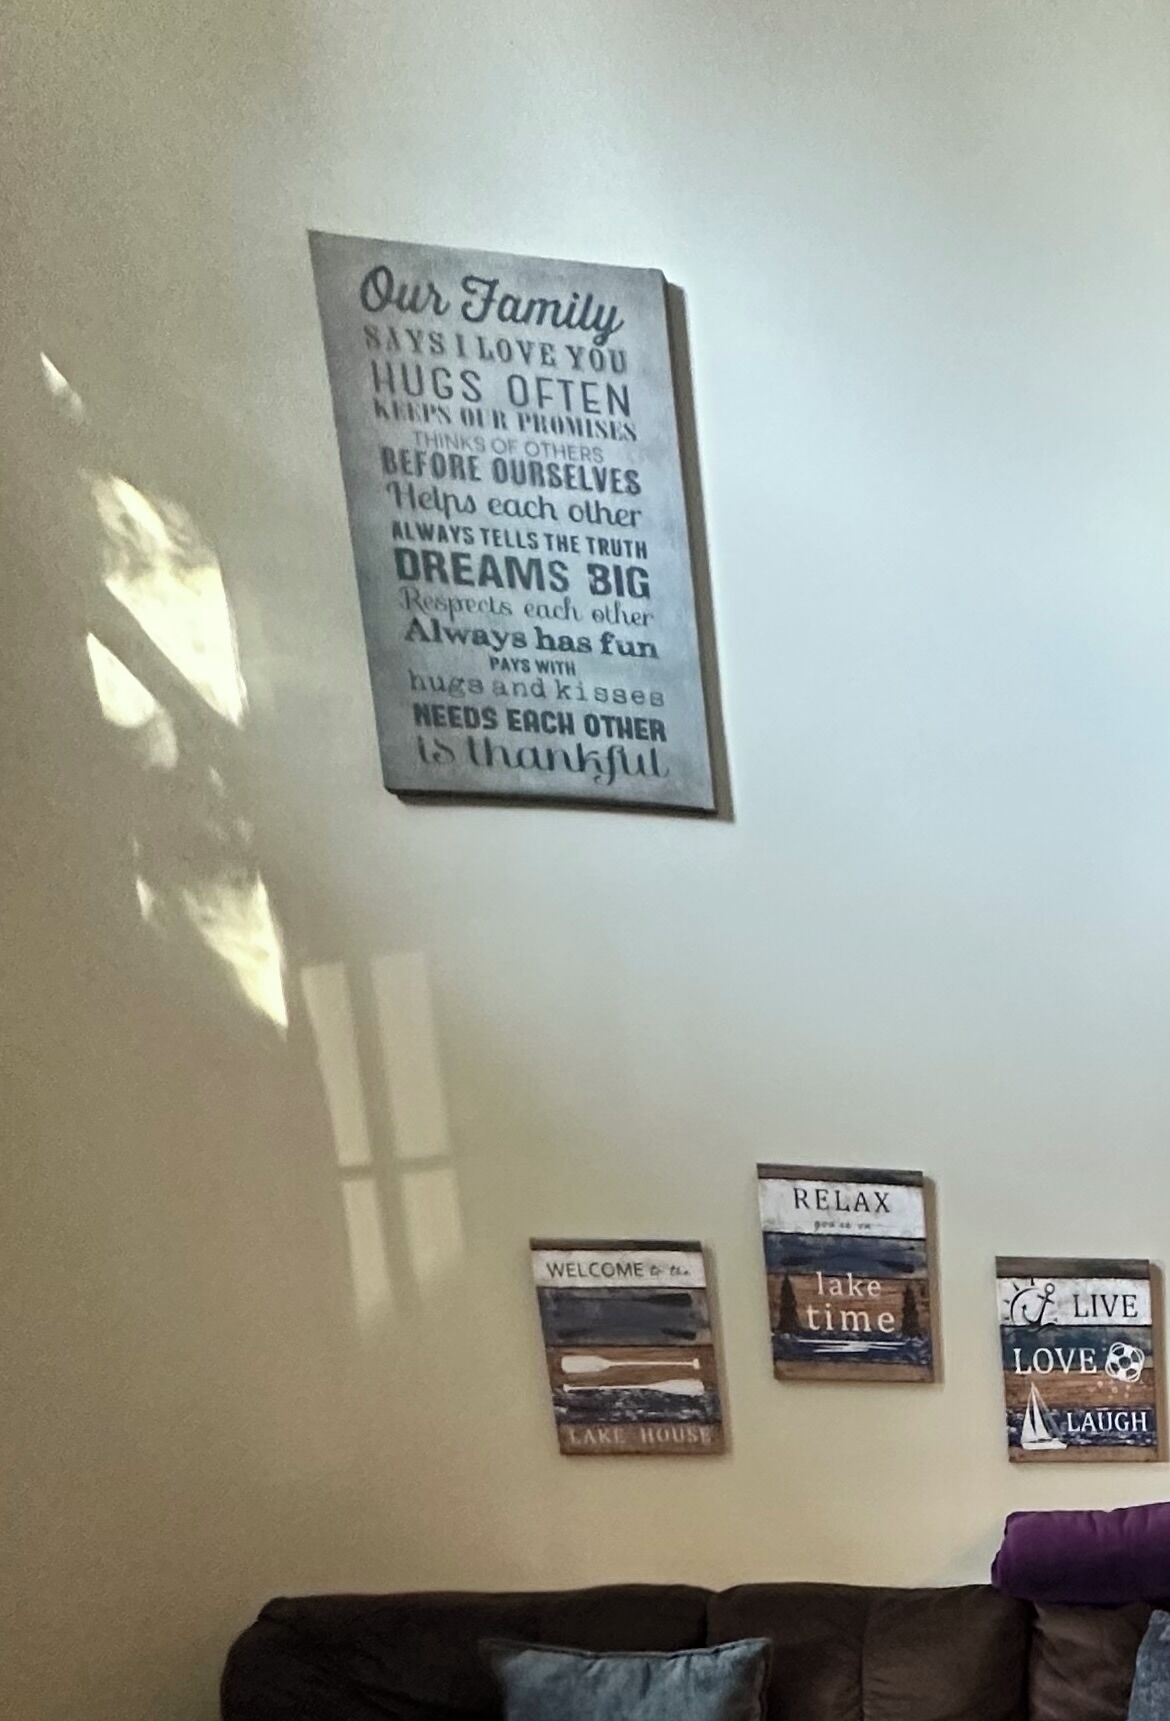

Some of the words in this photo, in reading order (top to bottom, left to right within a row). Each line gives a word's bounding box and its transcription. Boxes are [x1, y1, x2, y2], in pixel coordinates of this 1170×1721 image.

[360, 266, 450, 316] Our
[461, 275, 624, 346] Family
[364, 325, 445, 355] SAYS
[456, 336, 466, 358] I
[479, 337, 556, 367] LOVE
[565, 345, 628, 375] YOU
[370, 360, 482, 402] HUGS
[507, 374, 631, 417] OFTEN
[460, 407, 507, 432] OUR
[519, 413, 638, 442] PROMISES
[413, 430, 485, 453] THINKS
[490, 438, 518, 455] OF
[525, 442, 604, 463] OTHERS
[381, 446, 481, 482] BEFORE
[492, 457, 642, 495] OURSELVES
[387, 480, 477, 524] Helps
[488, 492, 557, 520] each
[568, 498, 642, 528] other
[392, 520, 475, 546] ALWAYS
[480, 528, 538, 550] TELLS
[544, 533, 580, 553] THE
[586, 536, 648, 560] TRUTH
[394, 547, 570, 593] DREAMS
[587, 562, 650, 599] BIG
[400, 586, 513, 621] Respects
[524, 596, 583, 622] each
[592, 599, 654, 627] other
[404, 617, 527, 652] Always
[535, 626, 592, 653] has
[600, 631, 660, 659] fun
[489, 656, 531, 674] PAYS
[535, 659, 576, 676] WITH
[408, 669, 484, 699] hugs
[492, 677, 546, 700] and
[556, 679, 665, 708] kisses
[414, 702, 498, 730] NEEDS
[507, 709, 575, 736] EACH
[584, 713, 667, 742] OTHER
[417, 735, 456, 765] is
[468, 736, 670, 786] thankful
[793, 1187, 891, 1214] RELAX
[546, 1261, 644, 1279] WELCOME
[816, 1271, 881, 1298] lake
[806, 1304, 896, 1334] time
[1073, 1294, 1139, 1318] LIVE
[1014, 1347, 1098, 1375] LOVE
[569, 1428, 626, 1445] LAKE
[641, 1427, 712, 1444] HOUSE
[1067, 1412, 1148, 1432] LAUGH
